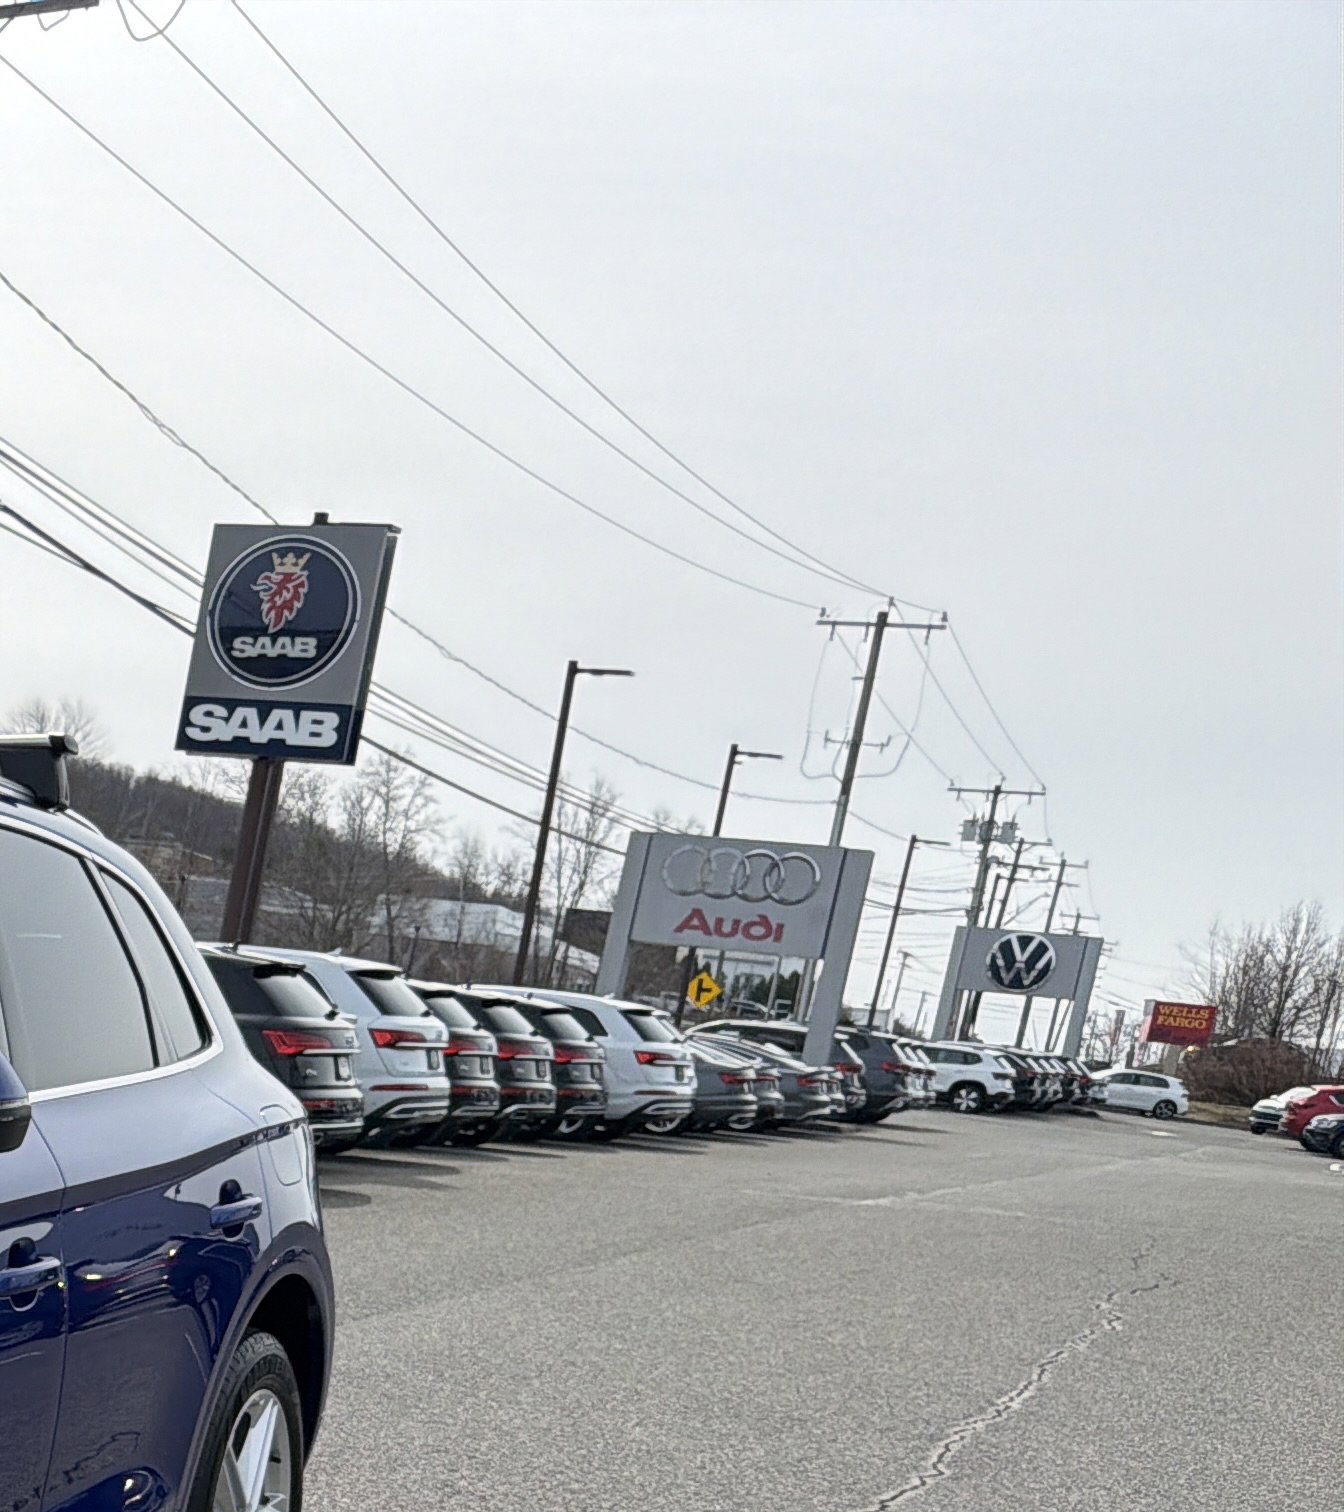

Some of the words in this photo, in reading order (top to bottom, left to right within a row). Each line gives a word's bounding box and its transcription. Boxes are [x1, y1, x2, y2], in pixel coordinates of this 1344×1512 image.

[231, 636, 318, 659] SAAB
[184, 703, 340, 748] SAAB
[672, 907, 785, 944] Audi
[1156, 1015, 1207, 1029] FARGO
[1158, 1004, 1209, 1019] WELLS
